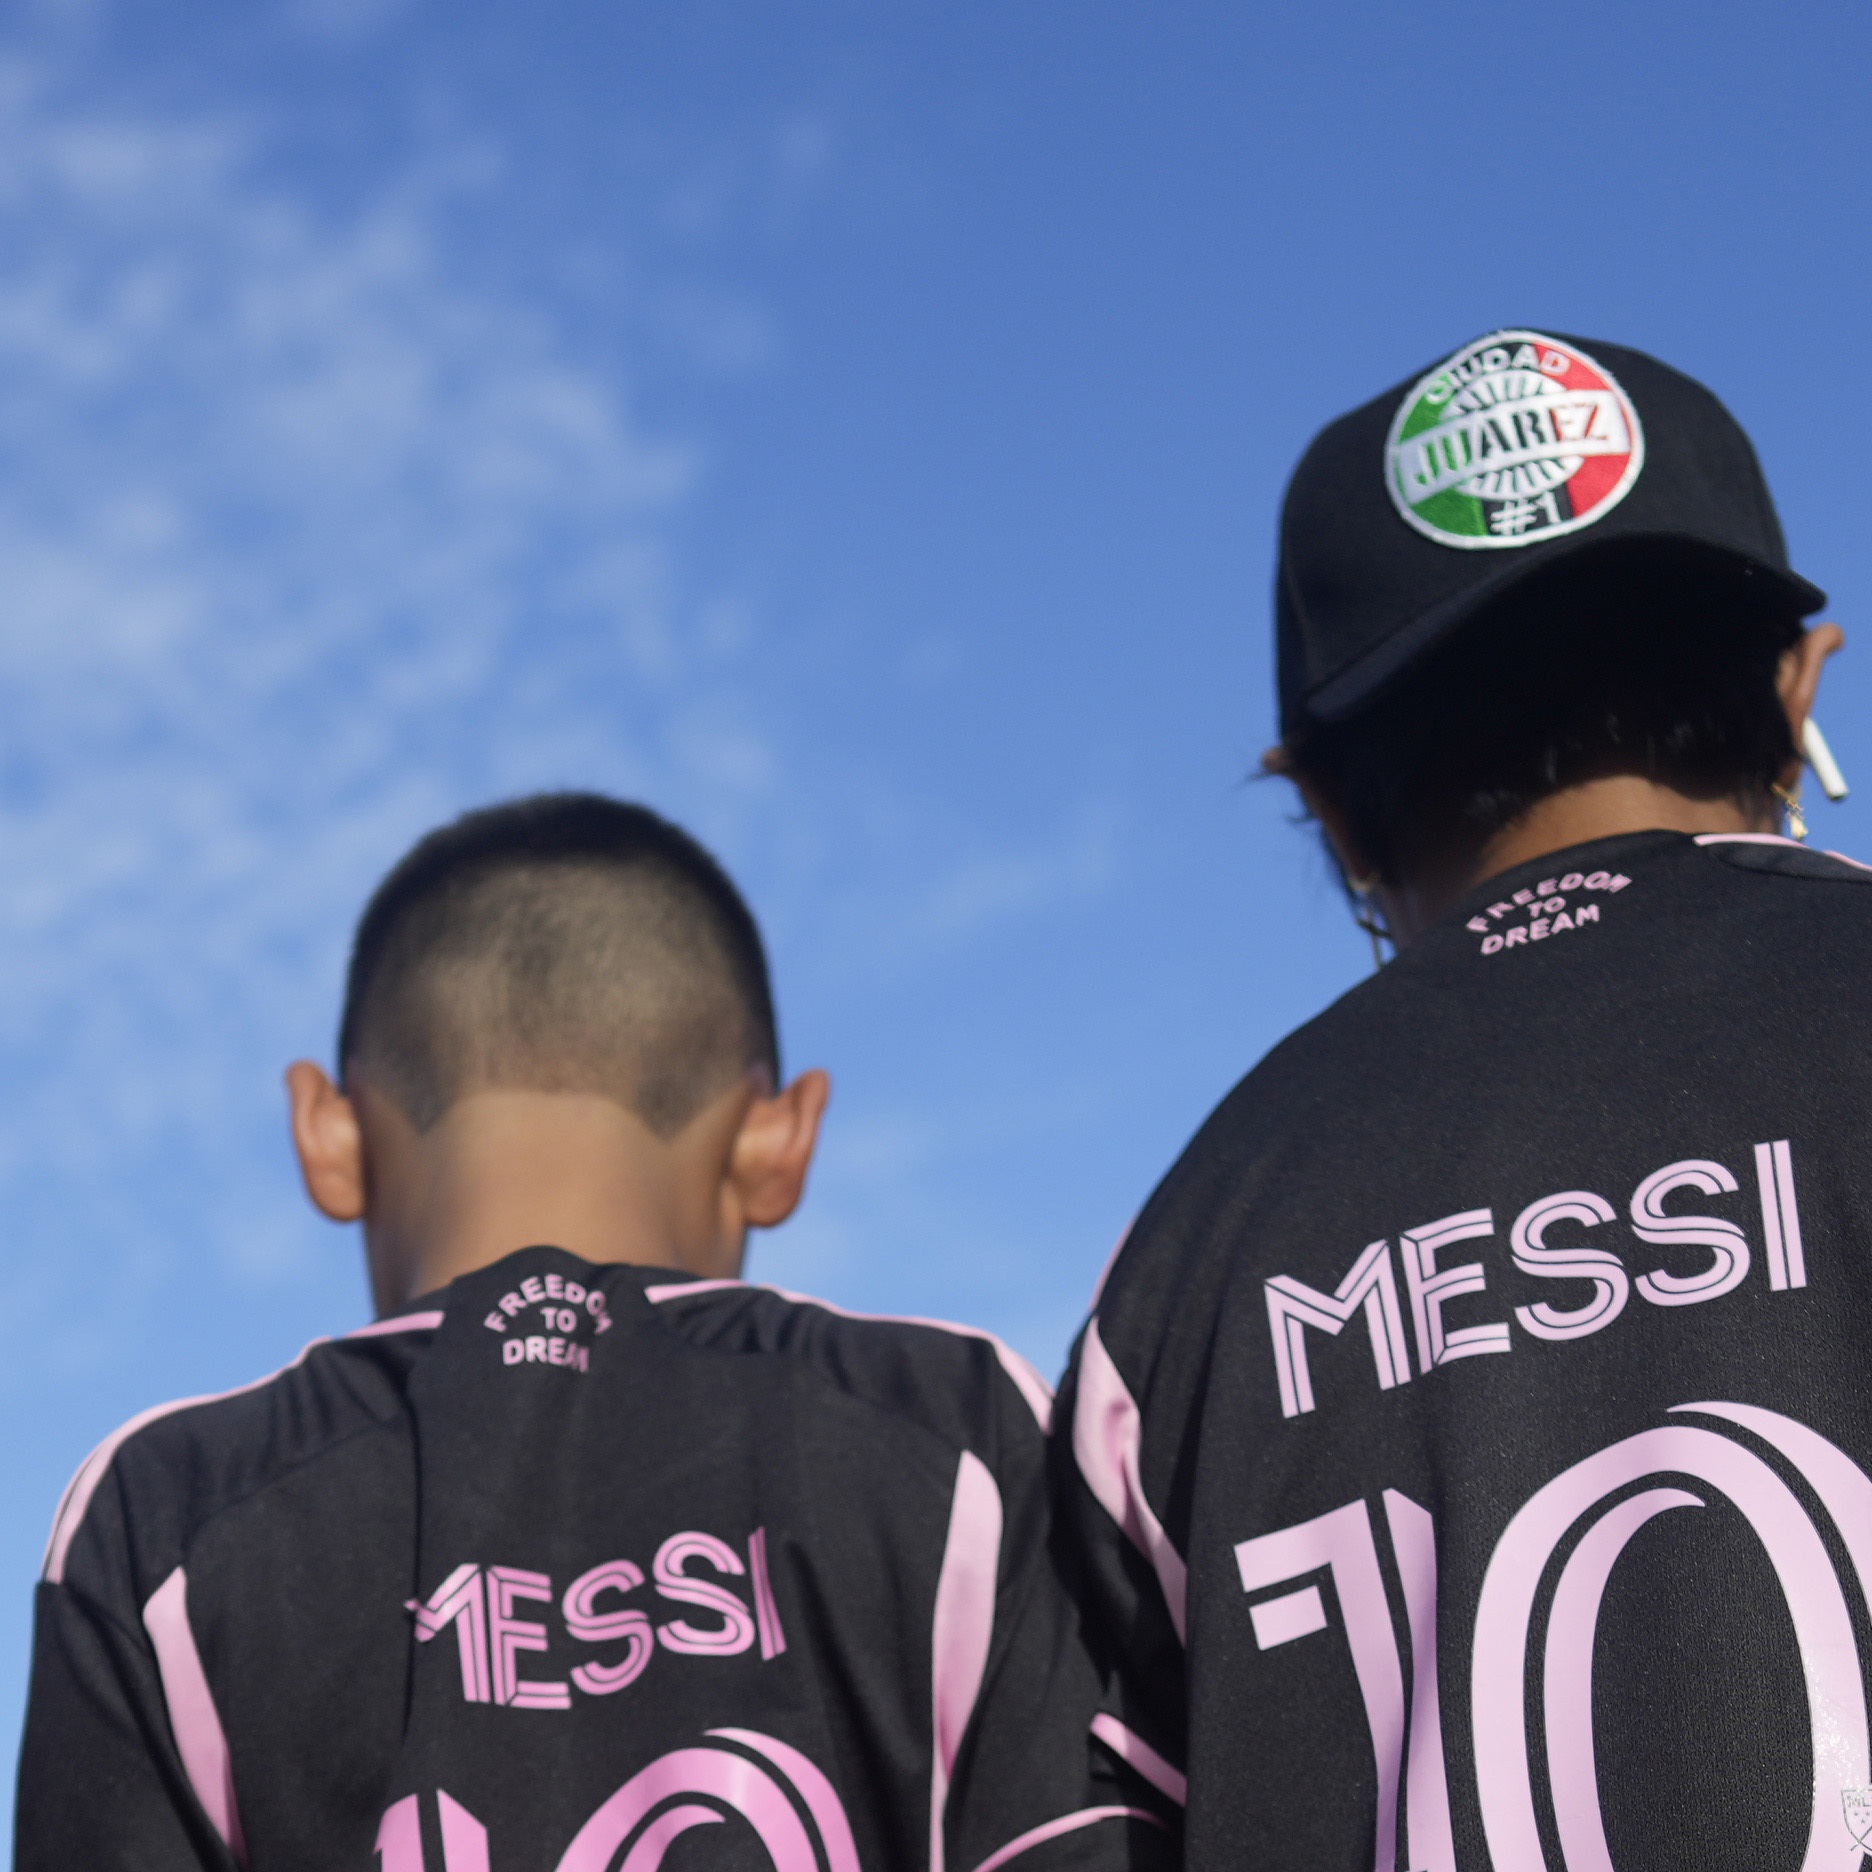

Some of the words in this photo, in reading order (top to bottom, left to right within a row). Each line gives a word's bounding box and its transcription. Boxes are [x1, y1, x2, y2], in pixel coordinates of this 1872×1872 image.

[1426, 343, 1571, 405] CIUDAD
[1414, 402, 1610, 486] JUAREZ
[1489, 490, 1563, 536] #1
[1480, 903, 1601, 957] DREAM
[1527, 896, 1567, 919] TO
[1263, 1139, 1807, 1419] MESSI
[539, 1306, 578, 1334] TO
